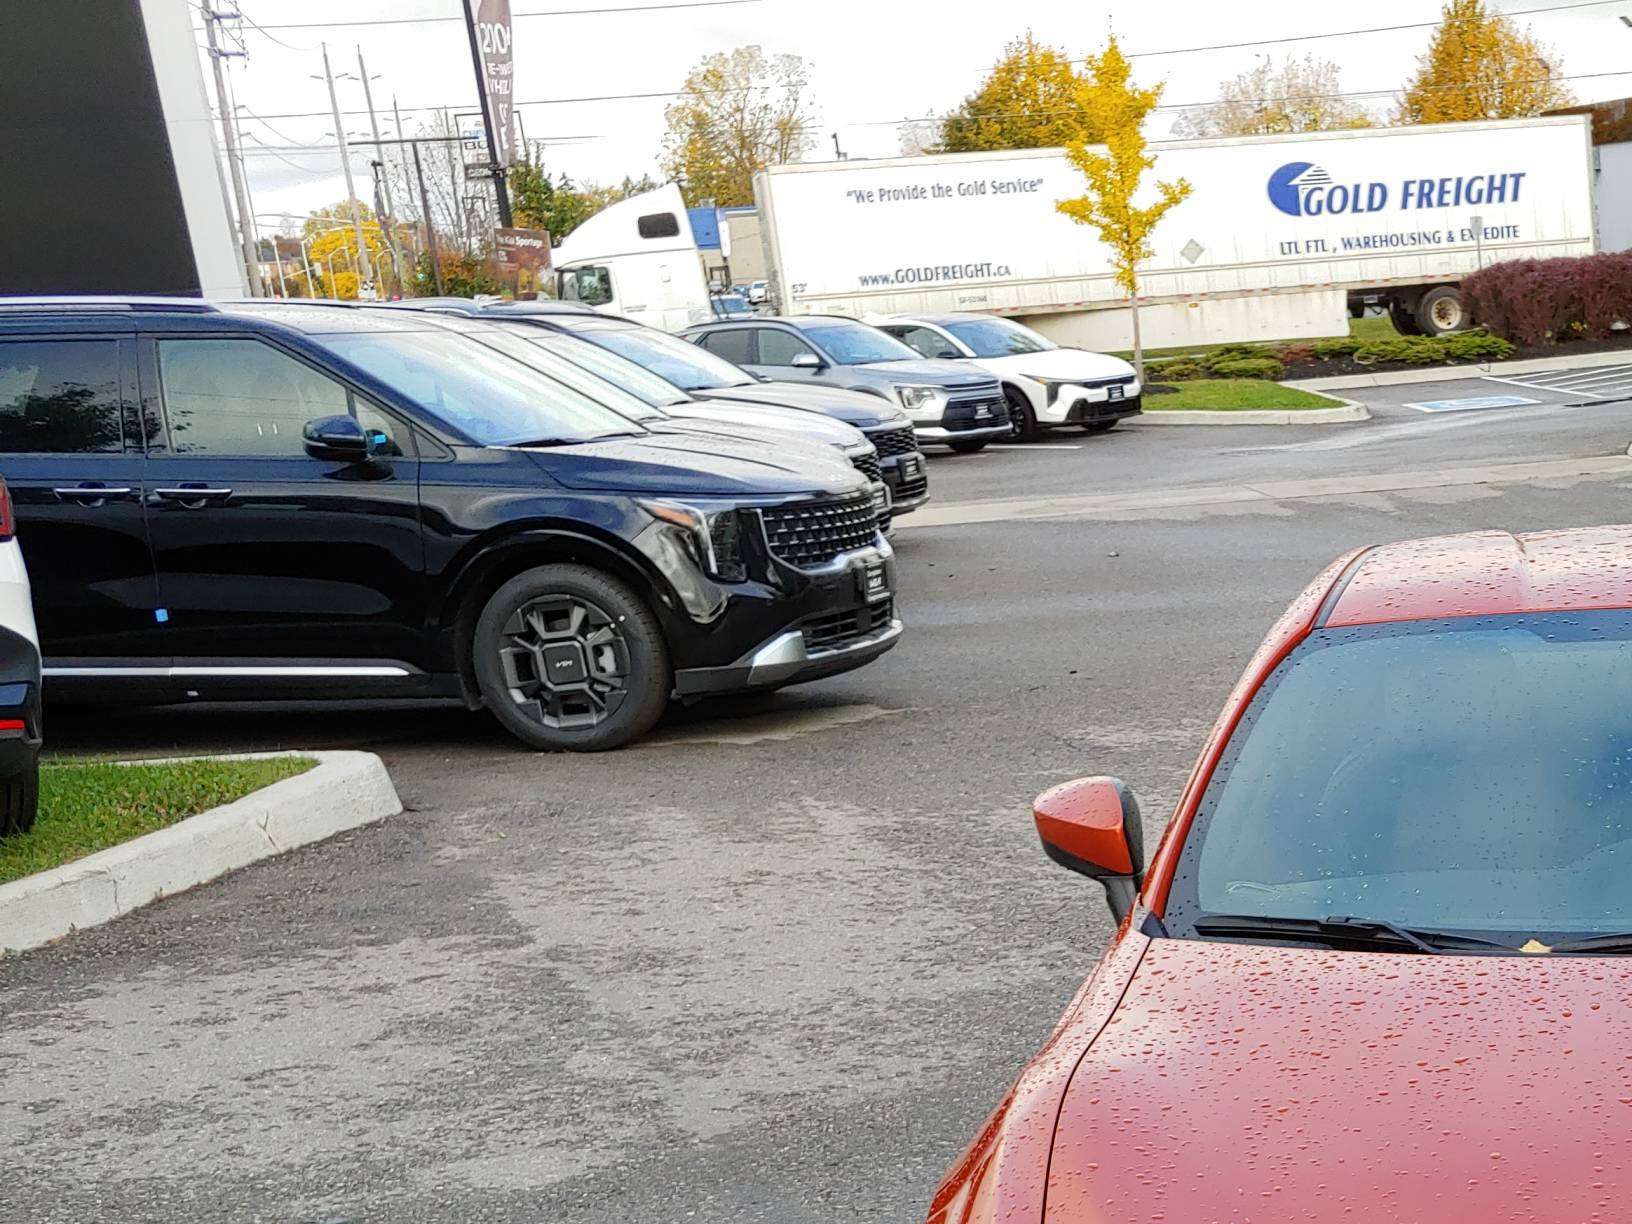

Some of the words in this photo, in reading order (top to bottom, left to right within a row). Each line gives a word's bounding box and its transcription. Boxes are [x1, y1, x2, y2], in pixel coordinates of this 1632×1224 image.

[879, 184, 927, 202] Provide
[931, 183, 953, 199] the
[957, 180, 987, 197] Gold
[1303, 182, 1388, 217] GOLD
[1400, 172, 1526, 210] FREIGHT
[1280, 241, 1301, 255] LTL
[1306, 239, 1329, 253] FTL
[1341, 230, 1442, 250] WAREHOUSING
[1447, 230, 1454, 242] &
[1460, 224, 1521, 242] EXEDITE
